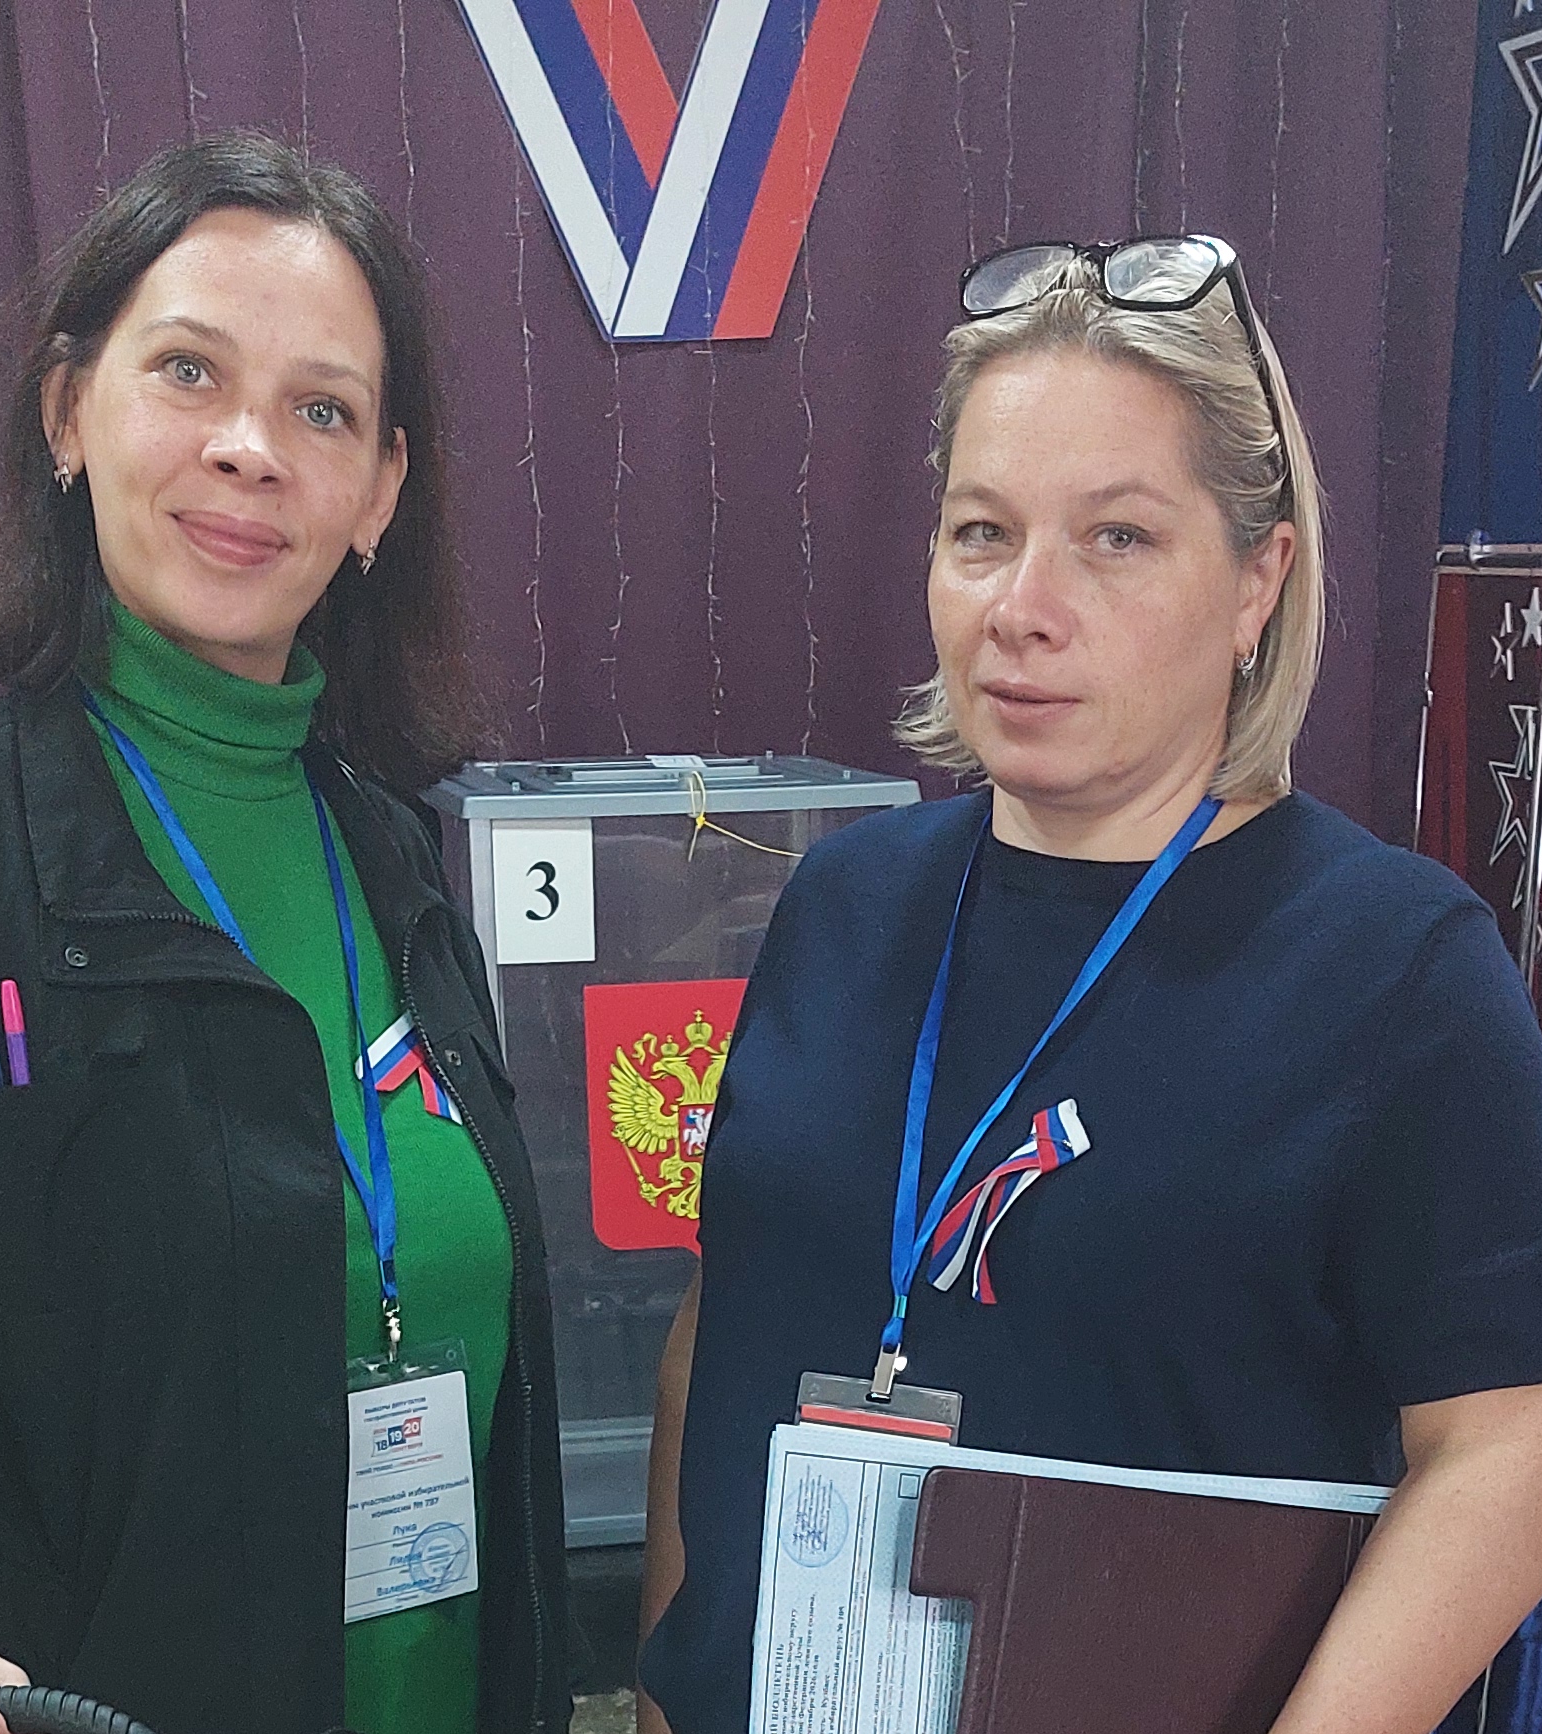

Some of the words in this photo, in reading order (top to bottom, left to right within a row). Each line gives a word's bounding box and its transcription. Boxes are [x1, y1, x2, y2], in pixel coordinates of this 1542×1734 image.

[525, 861, 560, 921] 3
[375, 1440, 388, 1451] 18
[389, 1430, 402, 1443] 19
[404, 1421, 419, 1434] 20
